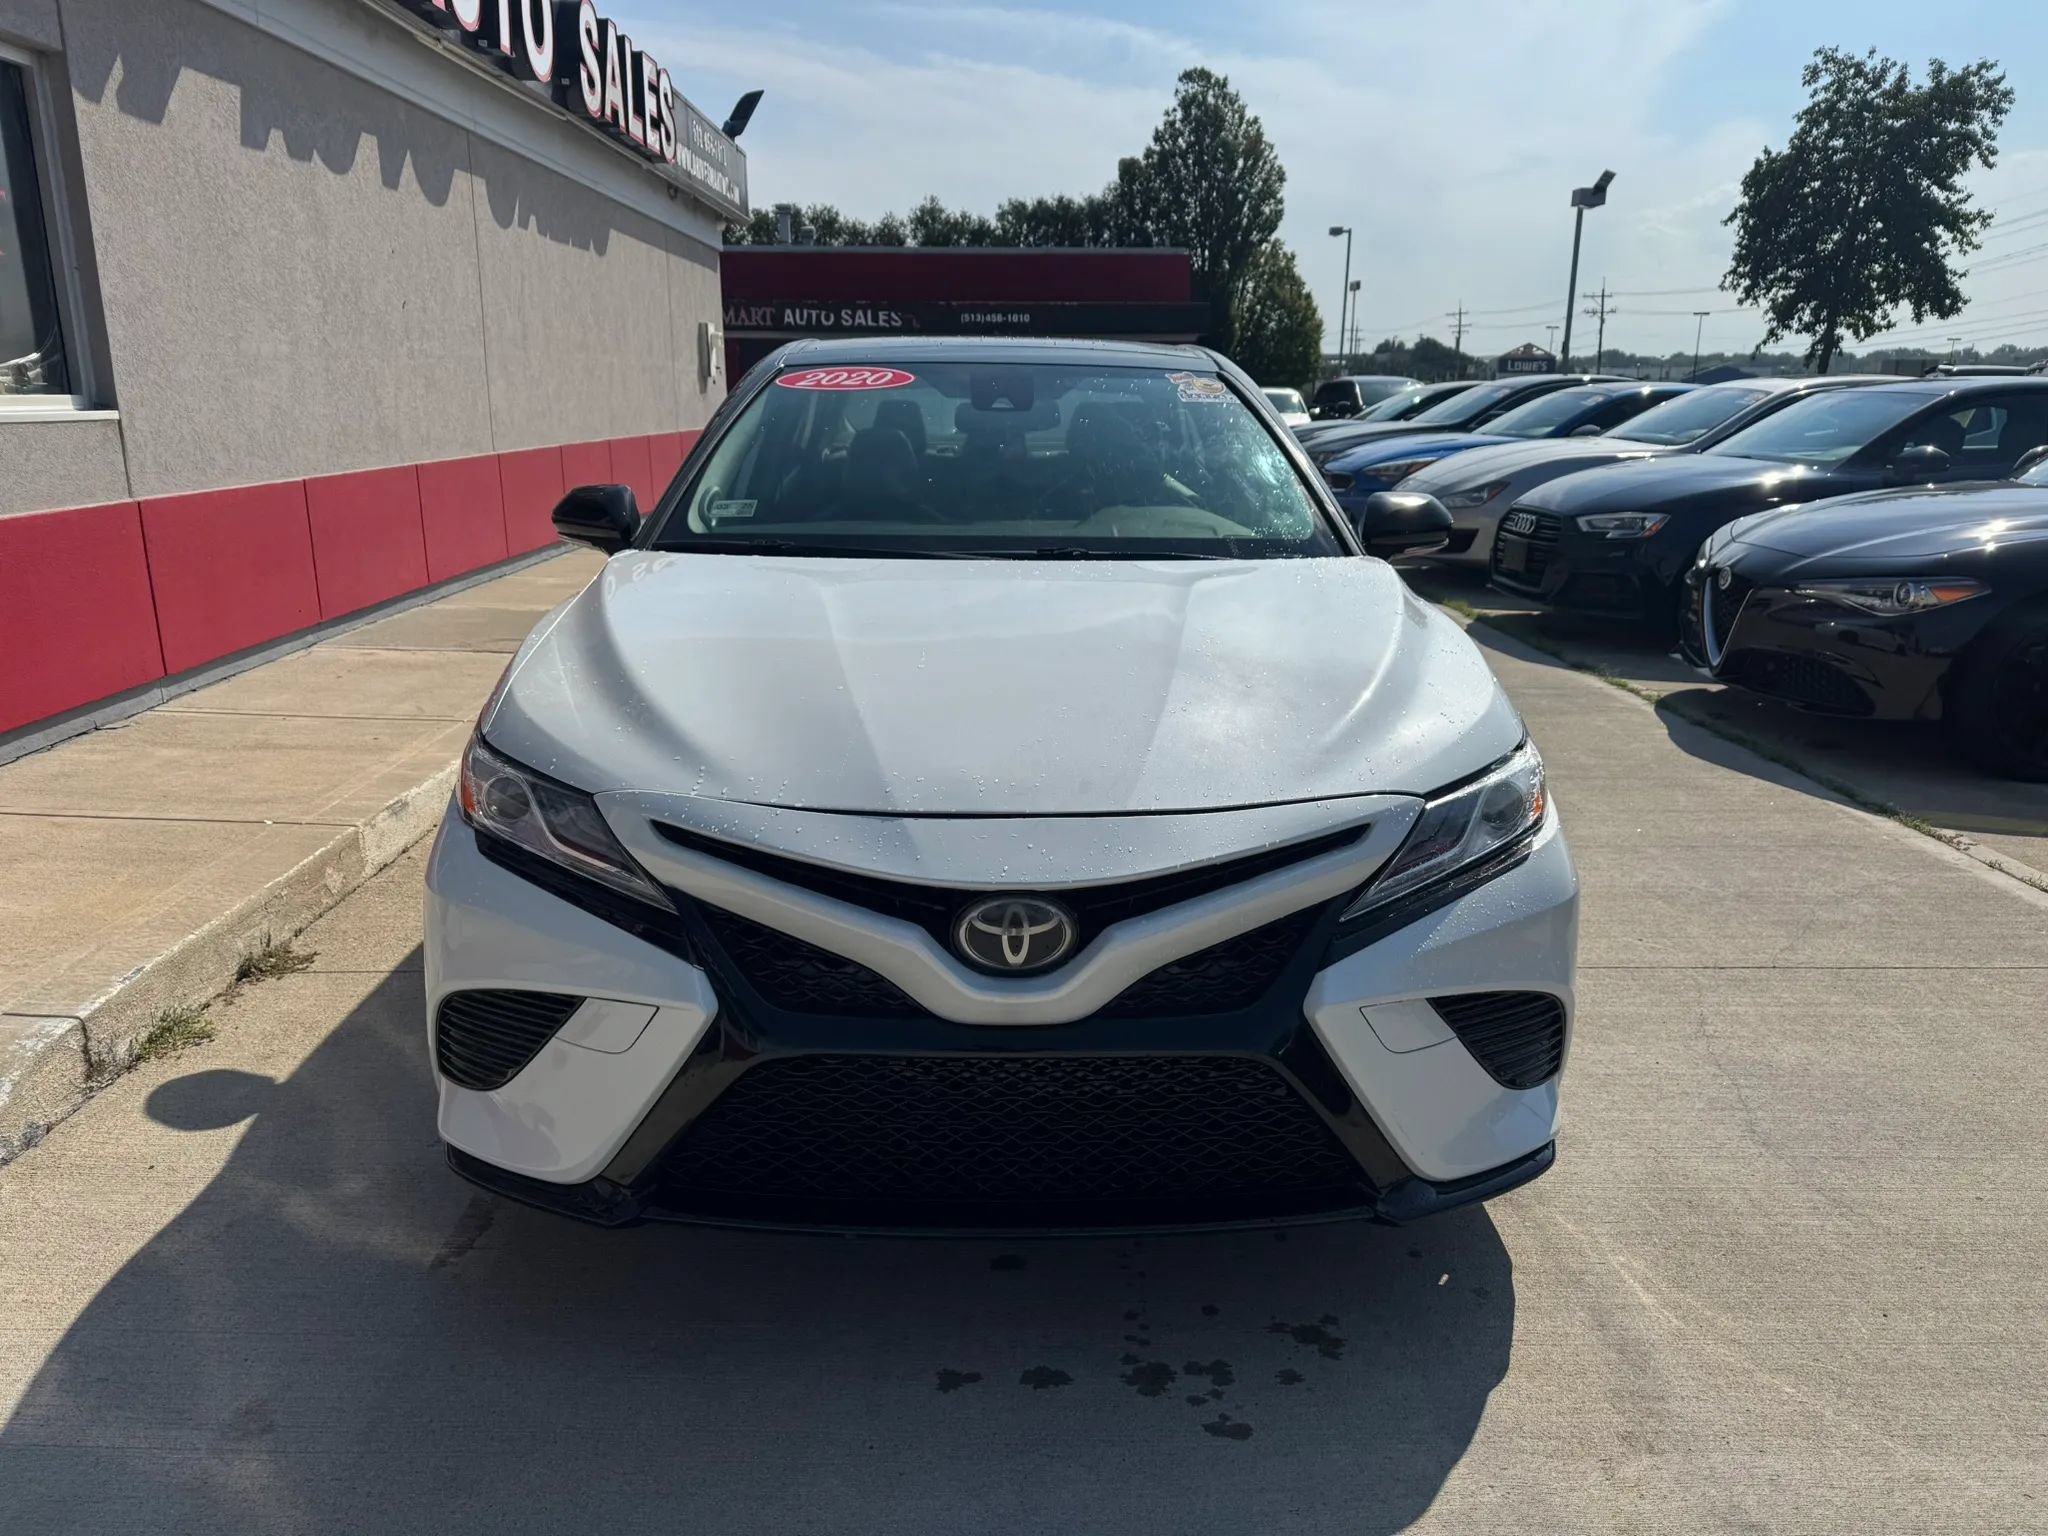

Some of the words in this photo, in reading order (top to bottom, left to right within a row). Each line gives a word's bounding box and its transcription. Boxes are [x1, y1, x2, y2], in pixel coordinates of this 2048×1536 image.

[579, 0, 677, 164] SALES
[783, 307, 835, 327] AUTO
[840, 308, 902, 328] SALES
[1507, 359, 1548, 372] LOWE'S
[795, 371, 893, 385] 2020
